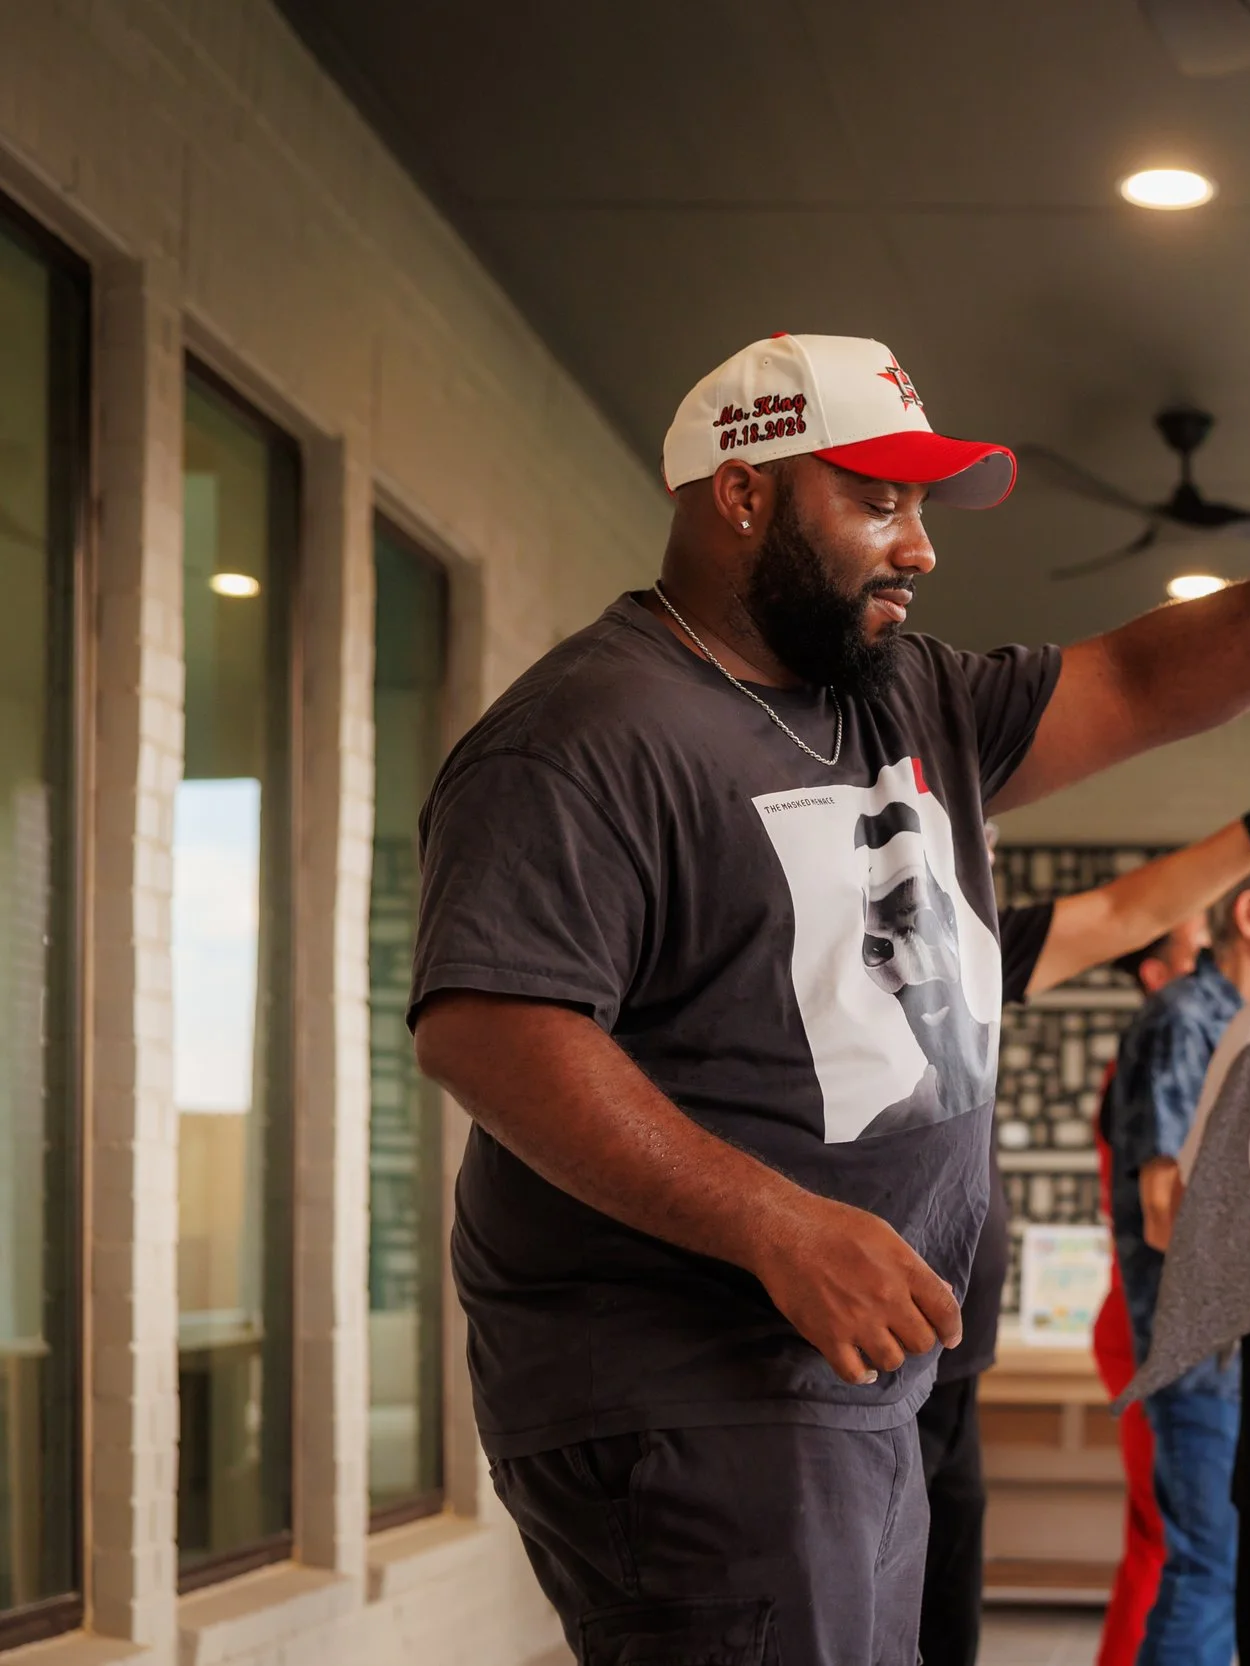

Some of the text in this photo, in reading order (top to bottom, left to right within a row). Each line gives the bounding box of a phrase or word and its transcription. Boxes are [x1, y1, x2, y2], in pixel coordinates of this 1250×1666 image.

[752, 393, 807, 416] King
[720, 414, 806, 450] 07.18.2026
[764, 797, 835, 814] THE MASKED MENACE
